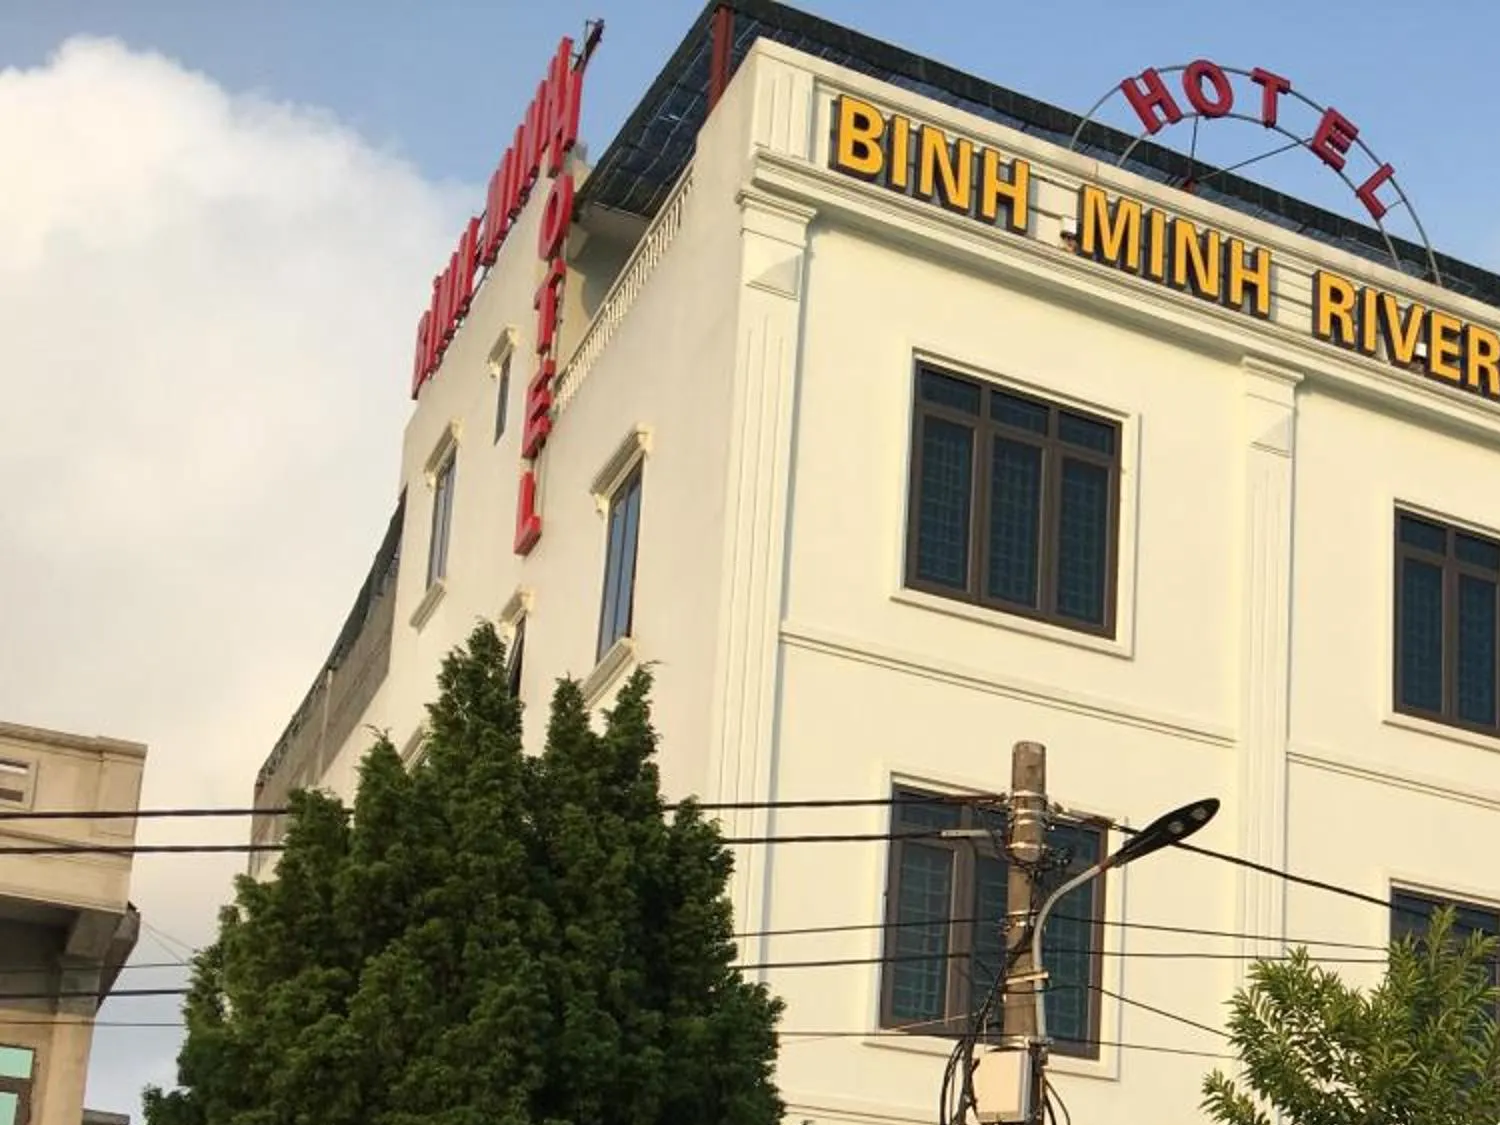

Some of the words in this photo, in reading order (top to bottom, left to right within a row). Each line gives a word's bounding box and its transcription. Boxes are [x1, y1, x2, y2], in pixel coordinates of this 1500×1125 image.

[830, 93, 1031, 233] BINH
[1079, 184, 1273, 317] MINH
[1120, 59, 1395, 221] HOTEL
[513, 70, 583, 556] HOTEL
